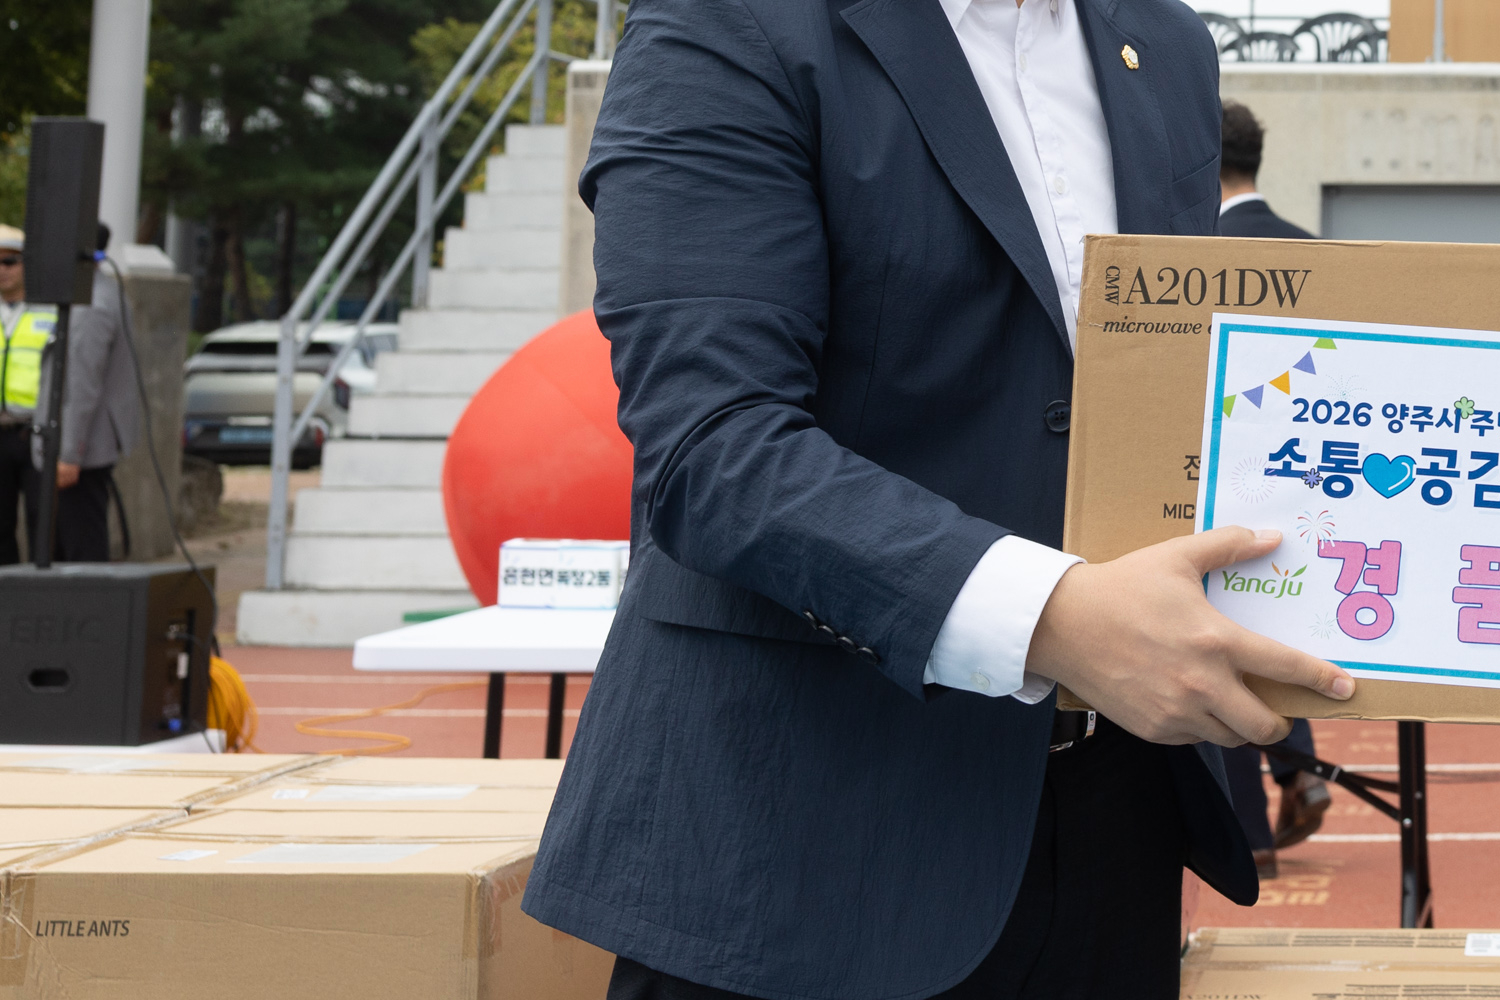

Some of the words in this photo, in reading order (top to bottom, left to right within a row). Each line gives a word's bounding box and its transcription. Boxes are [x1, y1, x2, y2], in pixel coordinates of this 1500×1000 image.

[1105, 265, 1121, 306] CMW
[1122, 265, 1312, 308] A201DW
[1102, 316, 1203, 334] microwave
[1292, 398, 1373, 427] 2026
[1381, 402, 1462, 434] 양주시
[1264, 437, 1363, 500] 소통
[1163, 503, 1195, 520] MIC
[36, 920, 86, 937] LITTLE
[87, 920, 130, 937] ANTS
